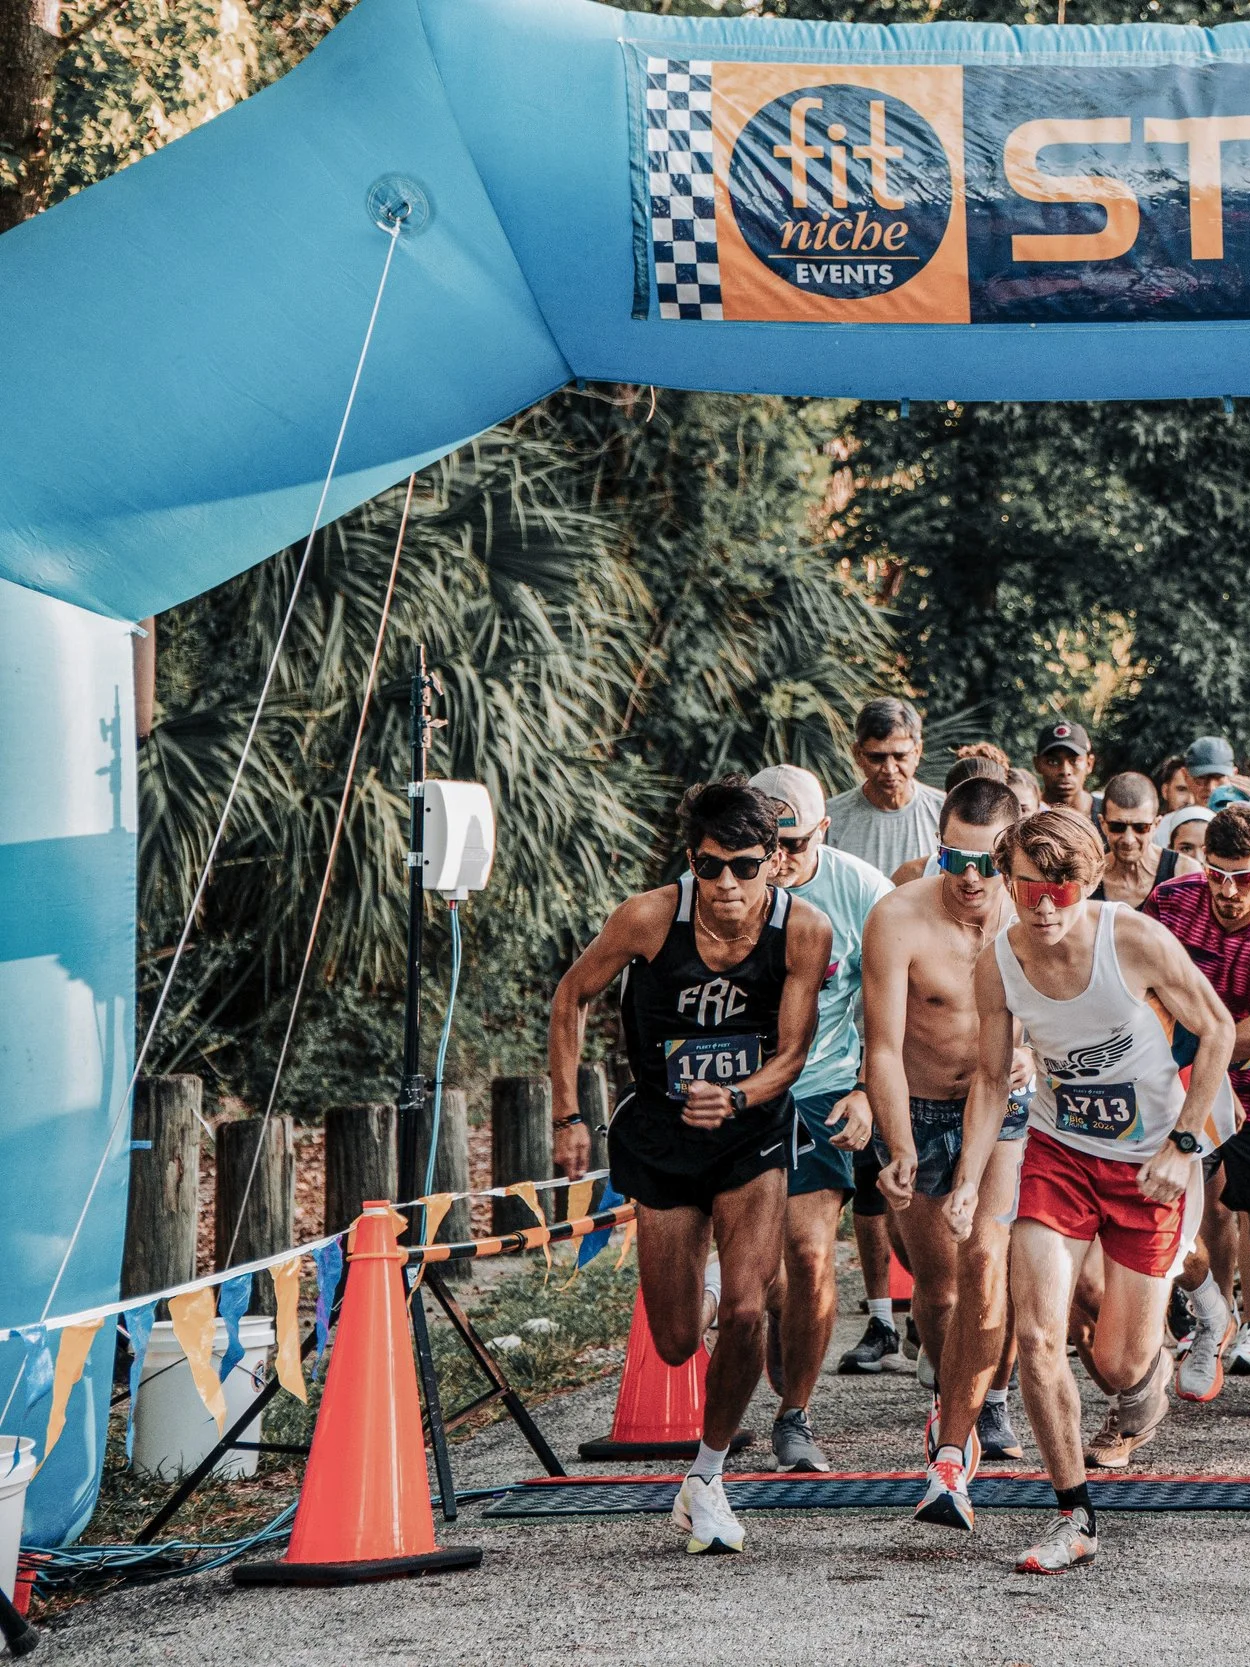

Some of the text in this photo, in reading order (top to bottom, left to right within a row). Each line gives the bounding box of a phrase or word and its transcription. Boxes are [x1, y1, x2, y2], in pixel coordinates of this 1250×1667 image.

[773, 97, 905, 211] fit
[780, 212, 909, 251] niche
[796, 263, 894, 285] EVENTS
[677, 977, 748, 1027] FRC
[678, 1050, 751, 1080] 1761
[1062, 1094, 1130, 1122] 1713
[1069, 1115, 1115, 1131] BIG 2024
